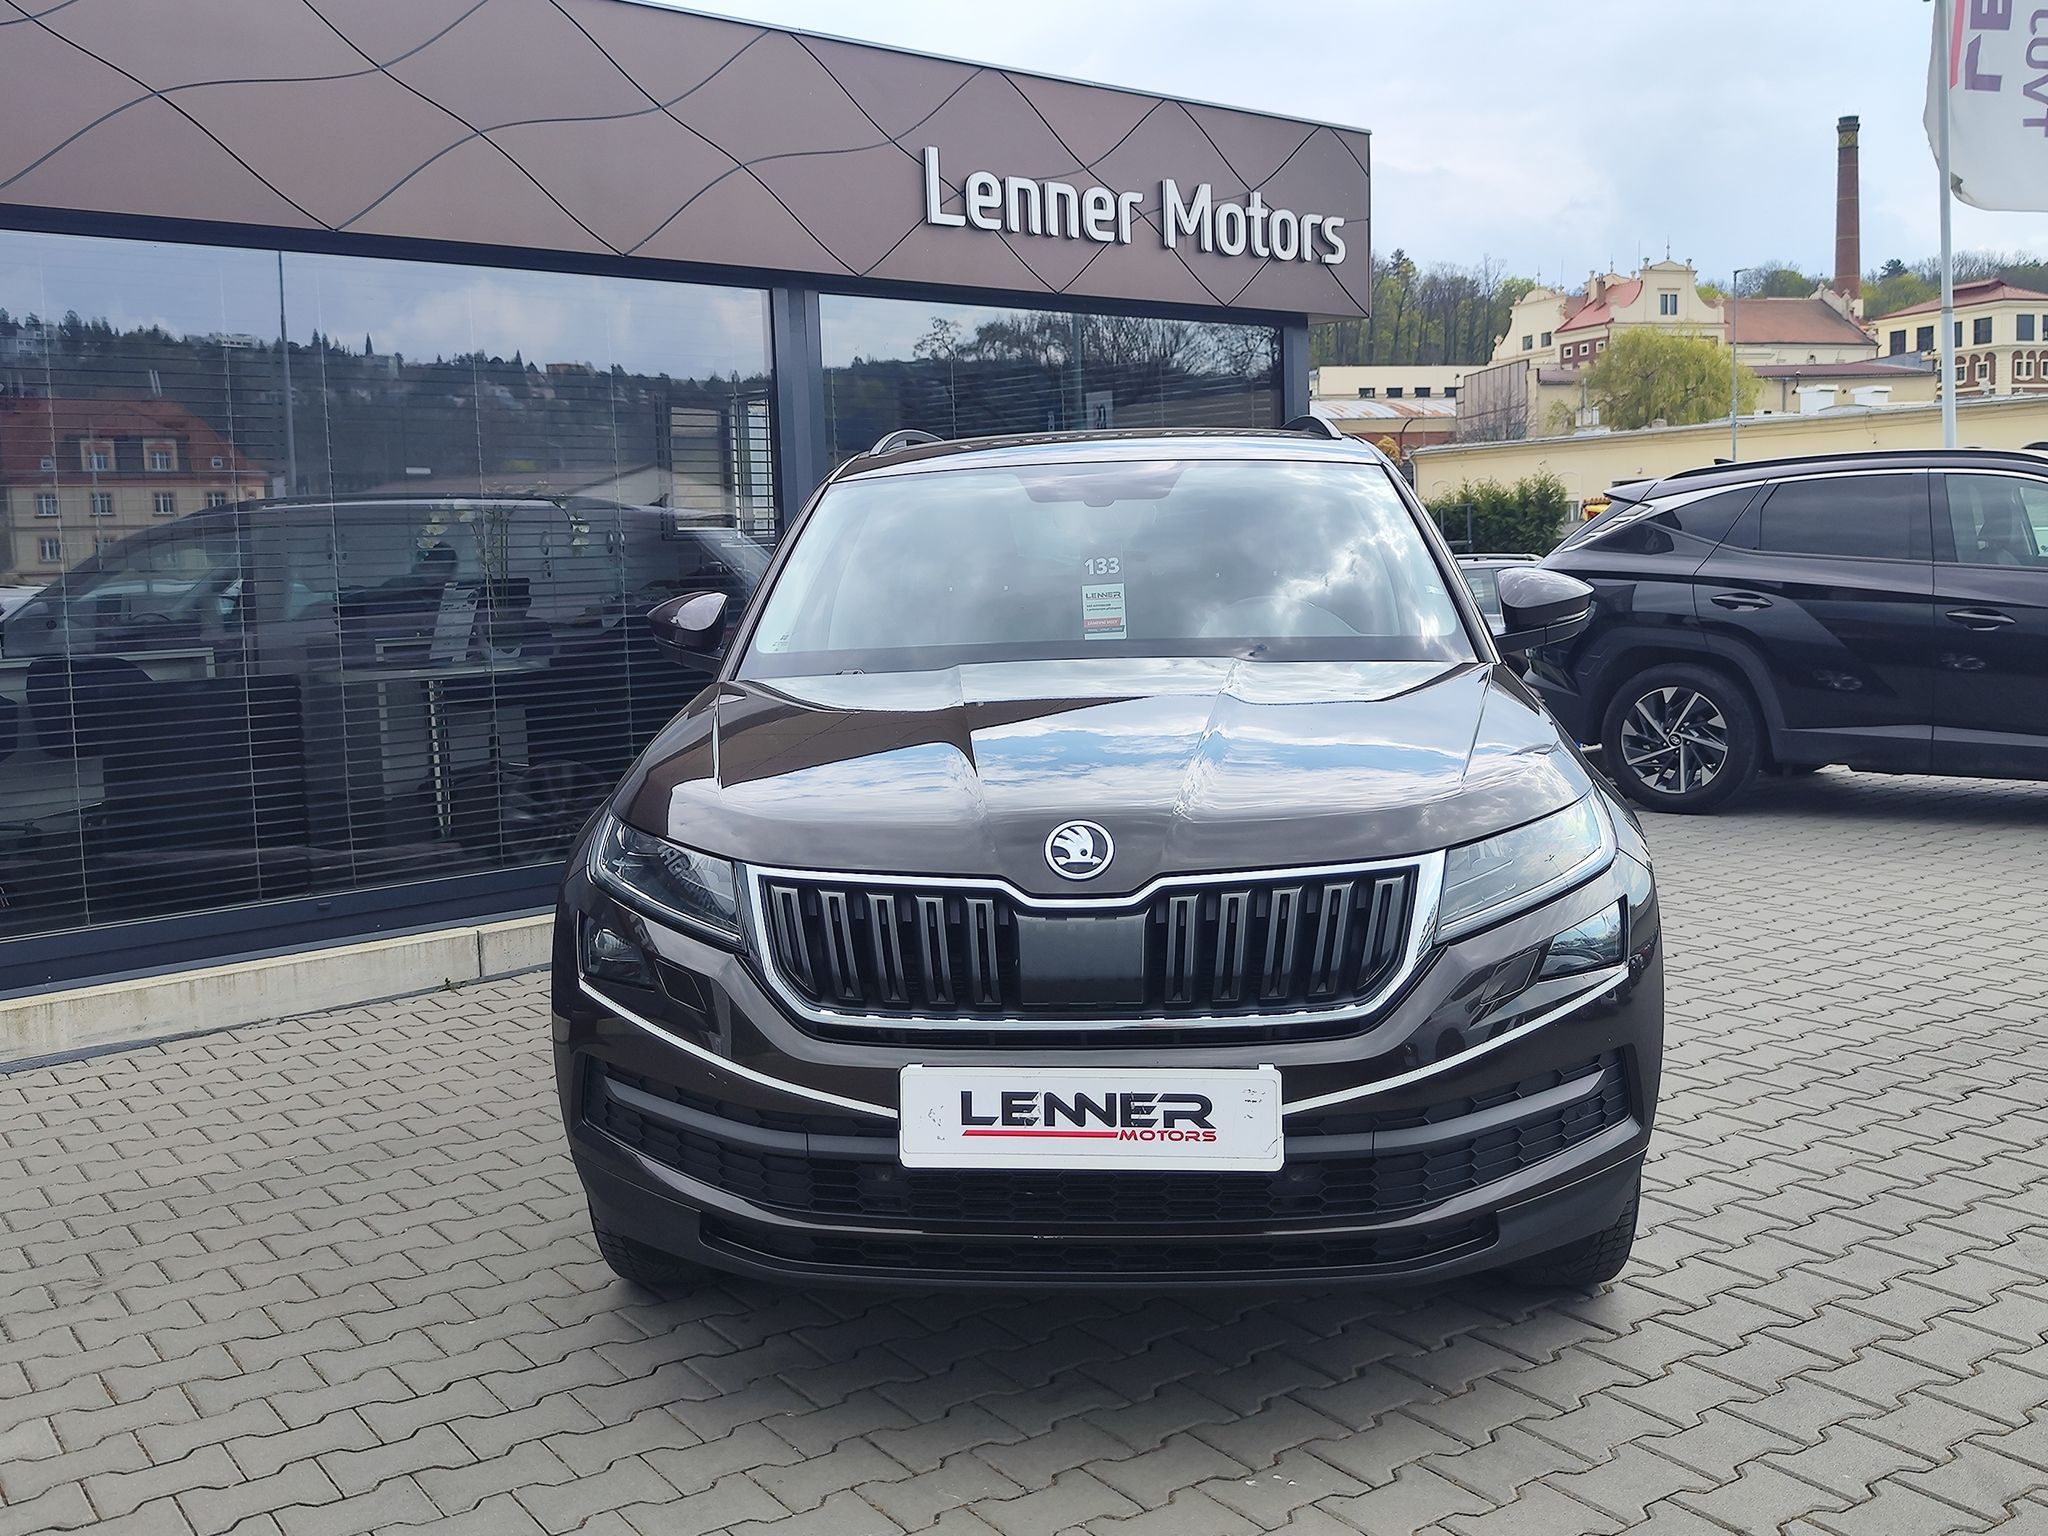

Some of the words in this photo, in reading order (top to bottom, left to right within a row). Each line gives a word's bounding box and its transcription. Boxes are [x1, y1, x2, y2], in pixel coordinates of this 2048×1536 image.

[923, 145, 1144, 245] Lenner
[1160, 178, 1347, 265] Motors
[1084, 557, 1120, 575] 133
[1085, 591, 1122, 599] LENNER
[960, 1090, 1217, 1129] LENNER
[1118, 1129, 1218, 1142] MOTORS
